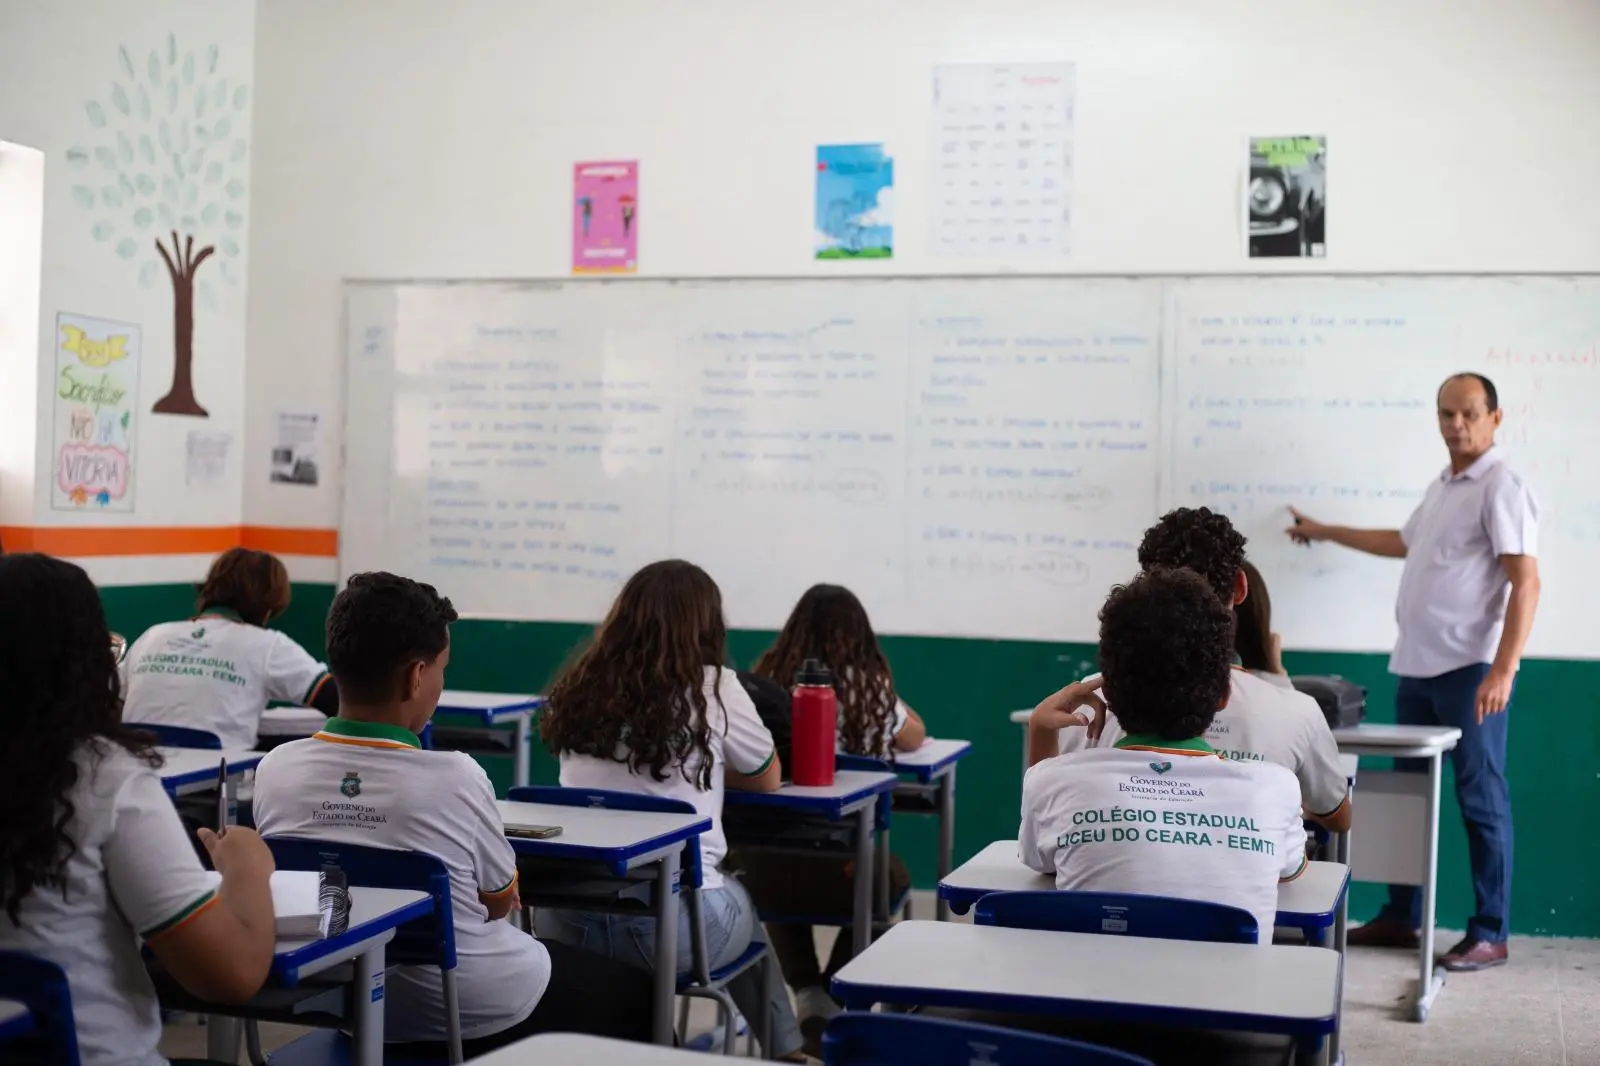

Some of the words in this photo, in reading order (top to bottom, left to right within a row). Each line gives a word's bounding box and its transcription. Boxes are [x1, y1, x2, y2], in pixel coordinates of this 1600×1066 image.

[180, 655, 236, 672] ESTADUAL
[1072, 805, 1157, 825] COLÉGIO
[1162, 810, 1260, 832] ESTADUAL
[1057, 828, 1106, 849] LICEU
[1112, 827, 1140, 842] DO
[1145, 829, 1212, 846] CEARA
[1227, 834, 1275, 856] EEMTI
